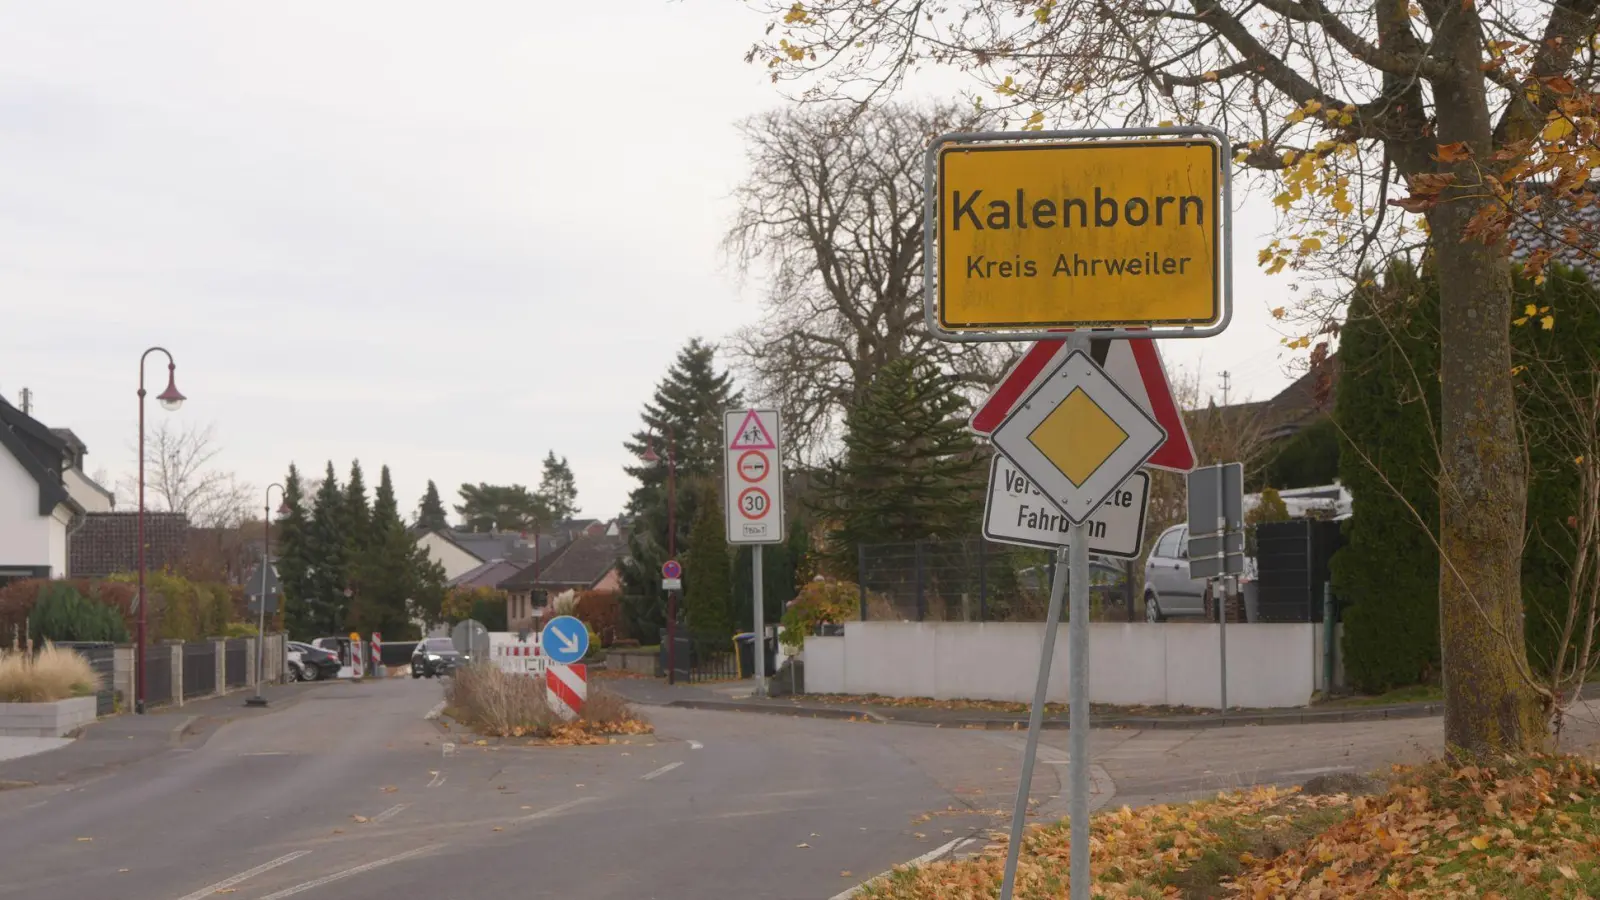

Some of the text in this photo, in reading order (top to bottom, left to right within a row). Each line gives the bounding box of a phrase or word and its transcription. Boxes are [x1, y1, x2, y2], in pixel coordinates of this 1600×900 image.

[952, 187, 1203, 231] Kalenborn
[966, 252, 1191, 278] Kreis Ahrweiler
[745, 495, 764, 511] 30
[1017, 504, 1106, 539] Fahrbn
